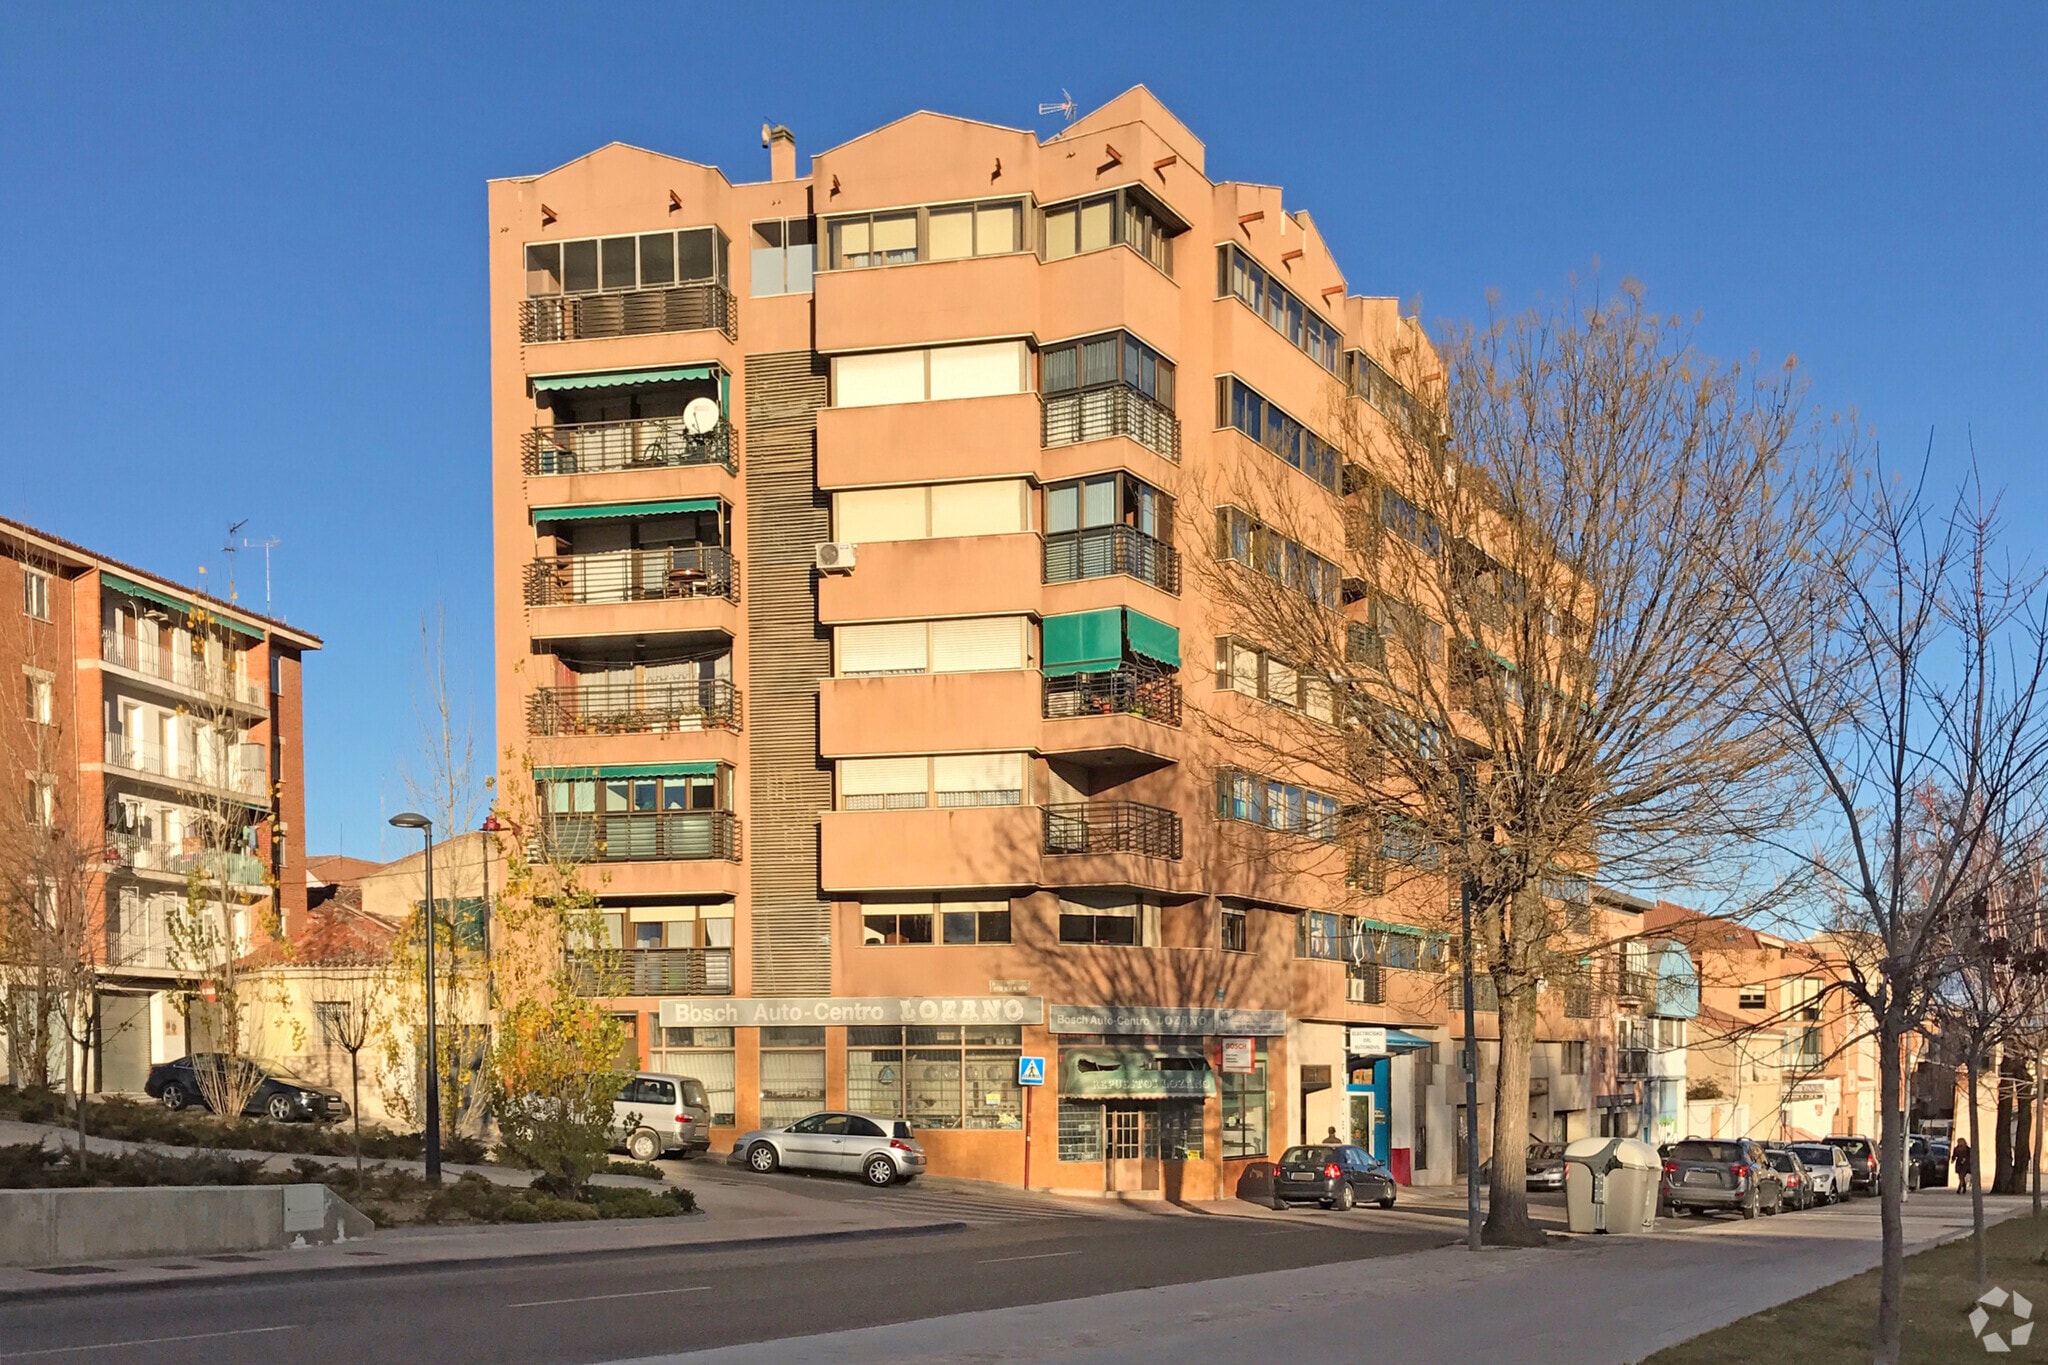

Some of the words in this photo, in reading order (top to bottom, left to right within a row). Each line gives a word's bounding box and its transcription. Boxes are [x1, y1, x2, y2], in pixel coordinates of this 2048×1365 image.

[675, 1003, 738, 1023] Bosch
[900, 999, 1024, 1023] LOZANO
[1057, 1014, 1089, 1025] Bosch
[1090, 1014, 1150, 1026] Auto-Centro
[1156, 1015, 1208, 1026] LOZANO
[1225, 1042, 1247, 1050] BOSCH
[1092, 1079, 1158, 1089] REPUESTOS
